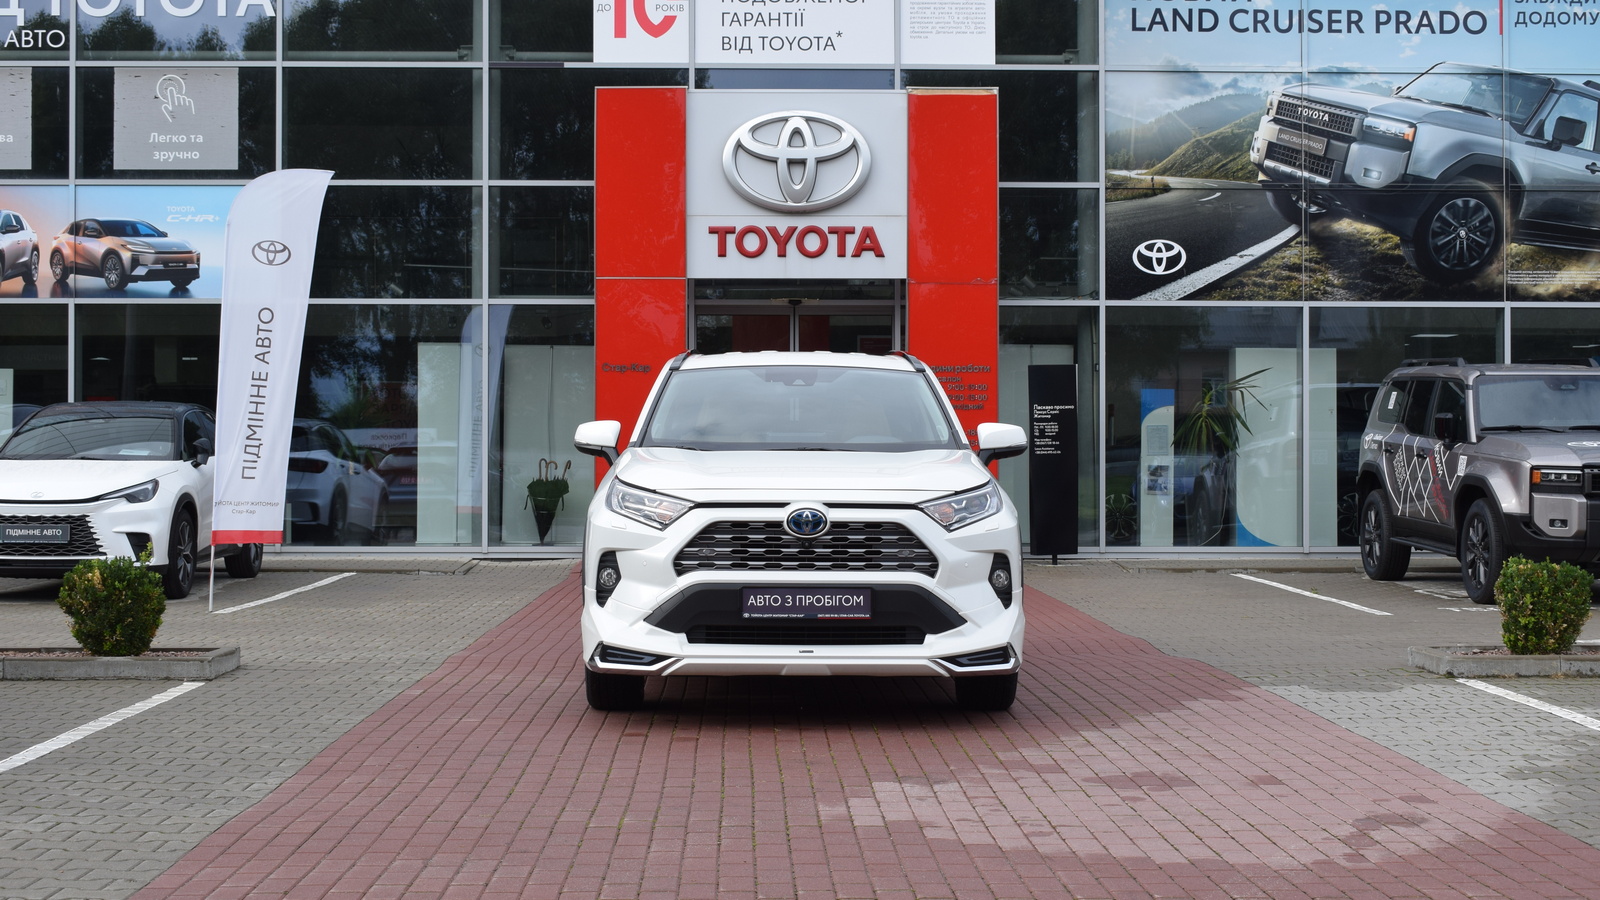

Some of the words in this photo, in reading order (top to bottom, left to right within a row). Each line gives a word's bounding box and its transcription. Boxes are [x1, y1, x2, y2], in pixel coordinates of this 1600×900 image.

[597, 4, 611, 12] ДО
[655, 4, 684, 12] РОКІВ
[721, 9, 805, 26] ГАРАНТІЇ
[1132, 8, 1219, 32] LAND
[1229, 9, 1364, 34] CRUISER
[1375, 10, 1487, 35] PRADO
[1515, 12, 1600, 28] ДОДОМУ
[4, 29, 66, 48] АВТО
[721, 36, 753, 54] ВІД
[1298, 107, 1329, 122] TOYOTA
[149, 132, 187, 143] Легко
[190, 133, 204, 143] та
[1278, 133, 1290, 141] LAND
[153, 152, 200, 162] зручно
[708, 225, 886, 258] TOYOTA
[254, 308, 274, 364] АВТО
[602, 363, 651, 373] Стар-Кар
[955, 364, 990, 374] роботи
[242, 371, 269, 480] ПІДМІННЕ
[748, 595, 781, 606] АВТО
[785, 595, 792, 606] З
[796, 595, 863, 606] ПРОБІГОМ
